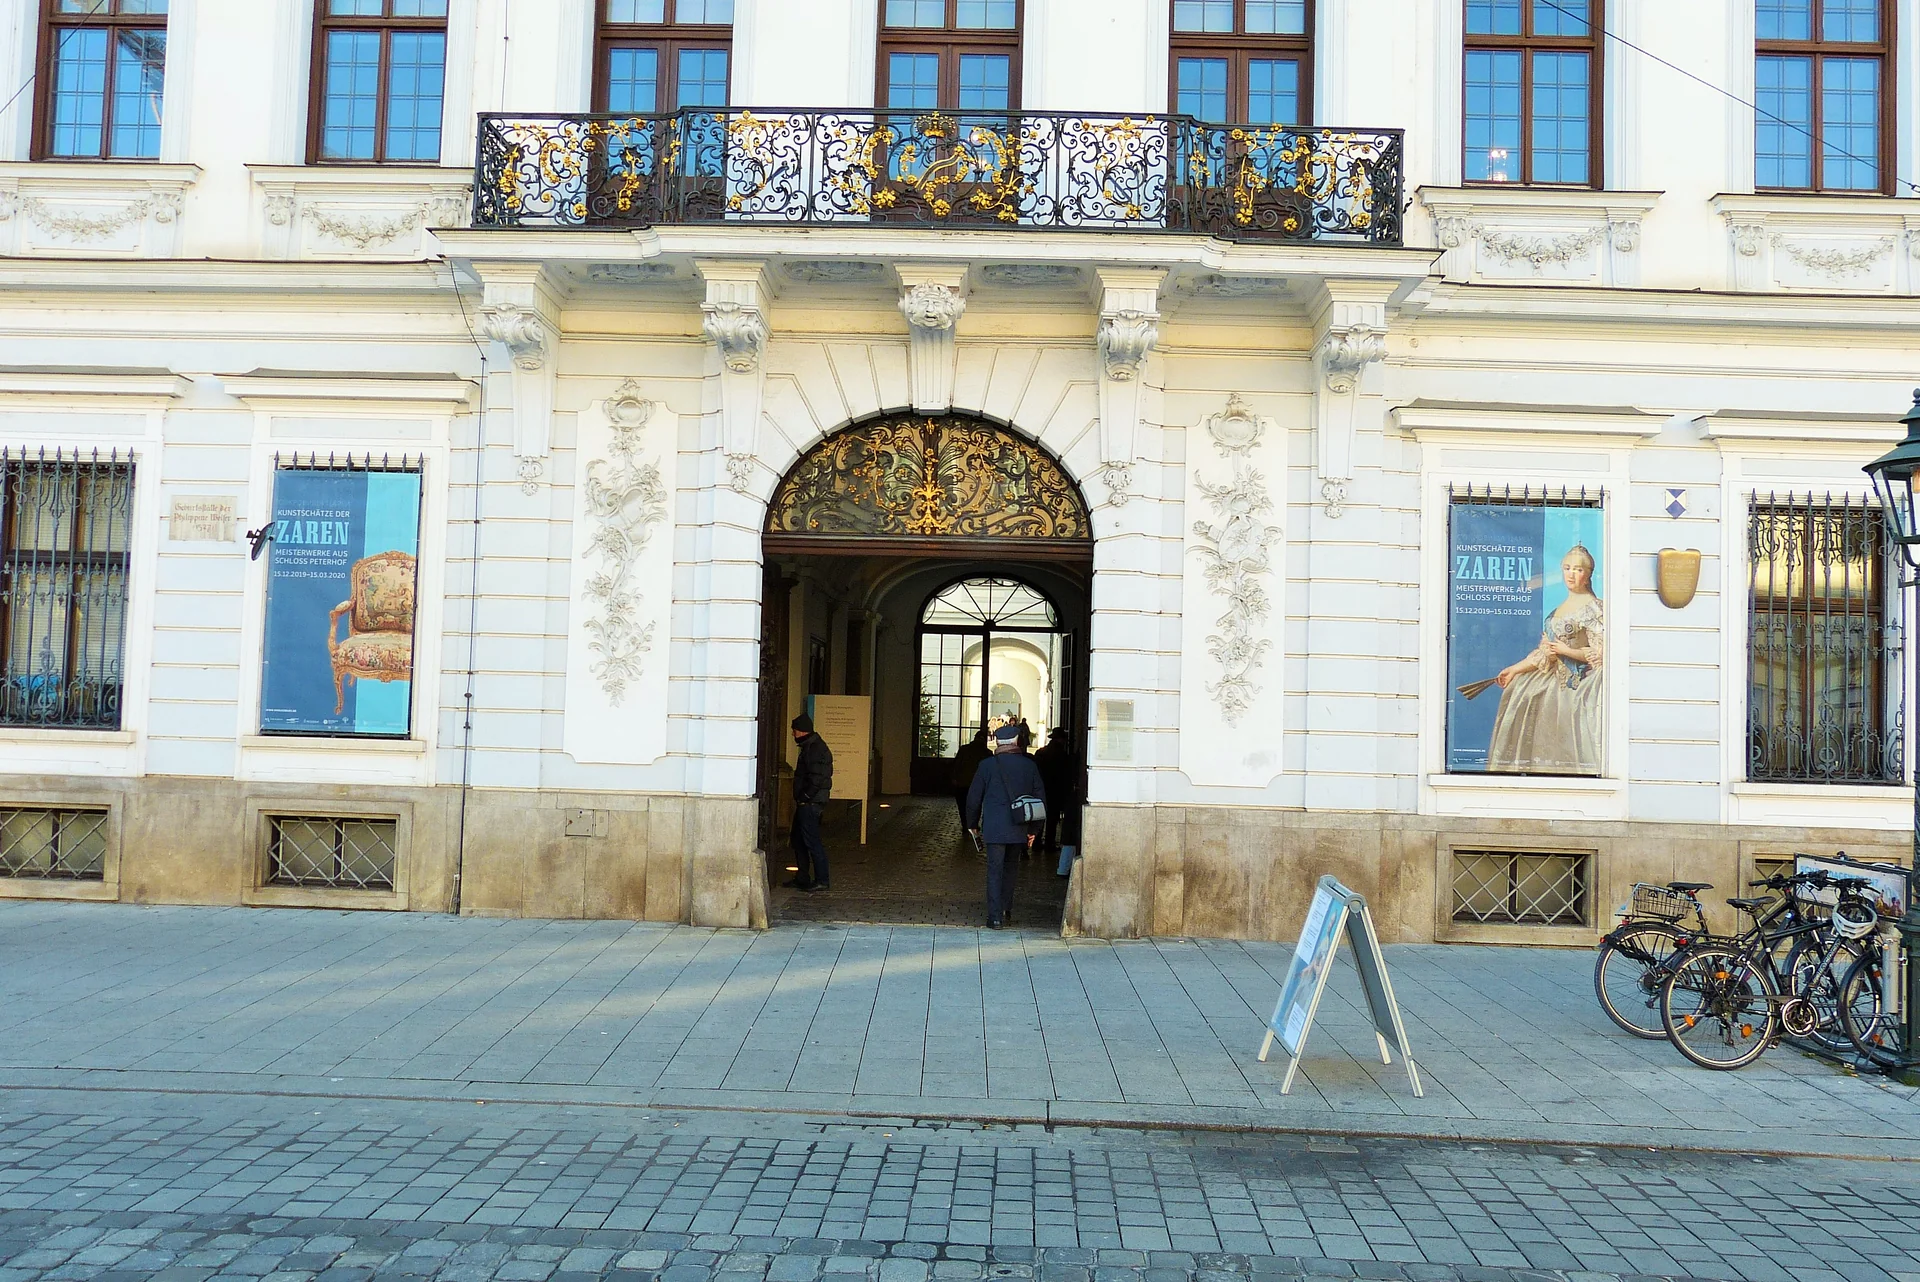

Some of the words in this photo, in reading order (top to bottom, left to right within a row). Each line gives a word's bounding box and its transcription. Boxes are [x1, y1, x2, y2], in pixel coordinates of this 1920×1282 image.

[277, 508, 334, 517] KUNSTSCHÄTZE
[275, 519, 350, 545] ZAREN
[275, 548, 331, 557] MEISTERWERKE
[1456, 544, 1516, 553] KUNSTSCHÄTZE
[274, 557, 308, 565] SCHLOSS
[309, 558, 348, 566] PETERHOF
[1455, 555, 1533, 581] ZAREN
[1456, 585, 1514, 593] MEISTERWERKE
[1516, 586, 1532, 594] AUS
[1455, 593, 1491, 601] SCHLOSS
[1492, 594, 1532, 602] PETERHOF
